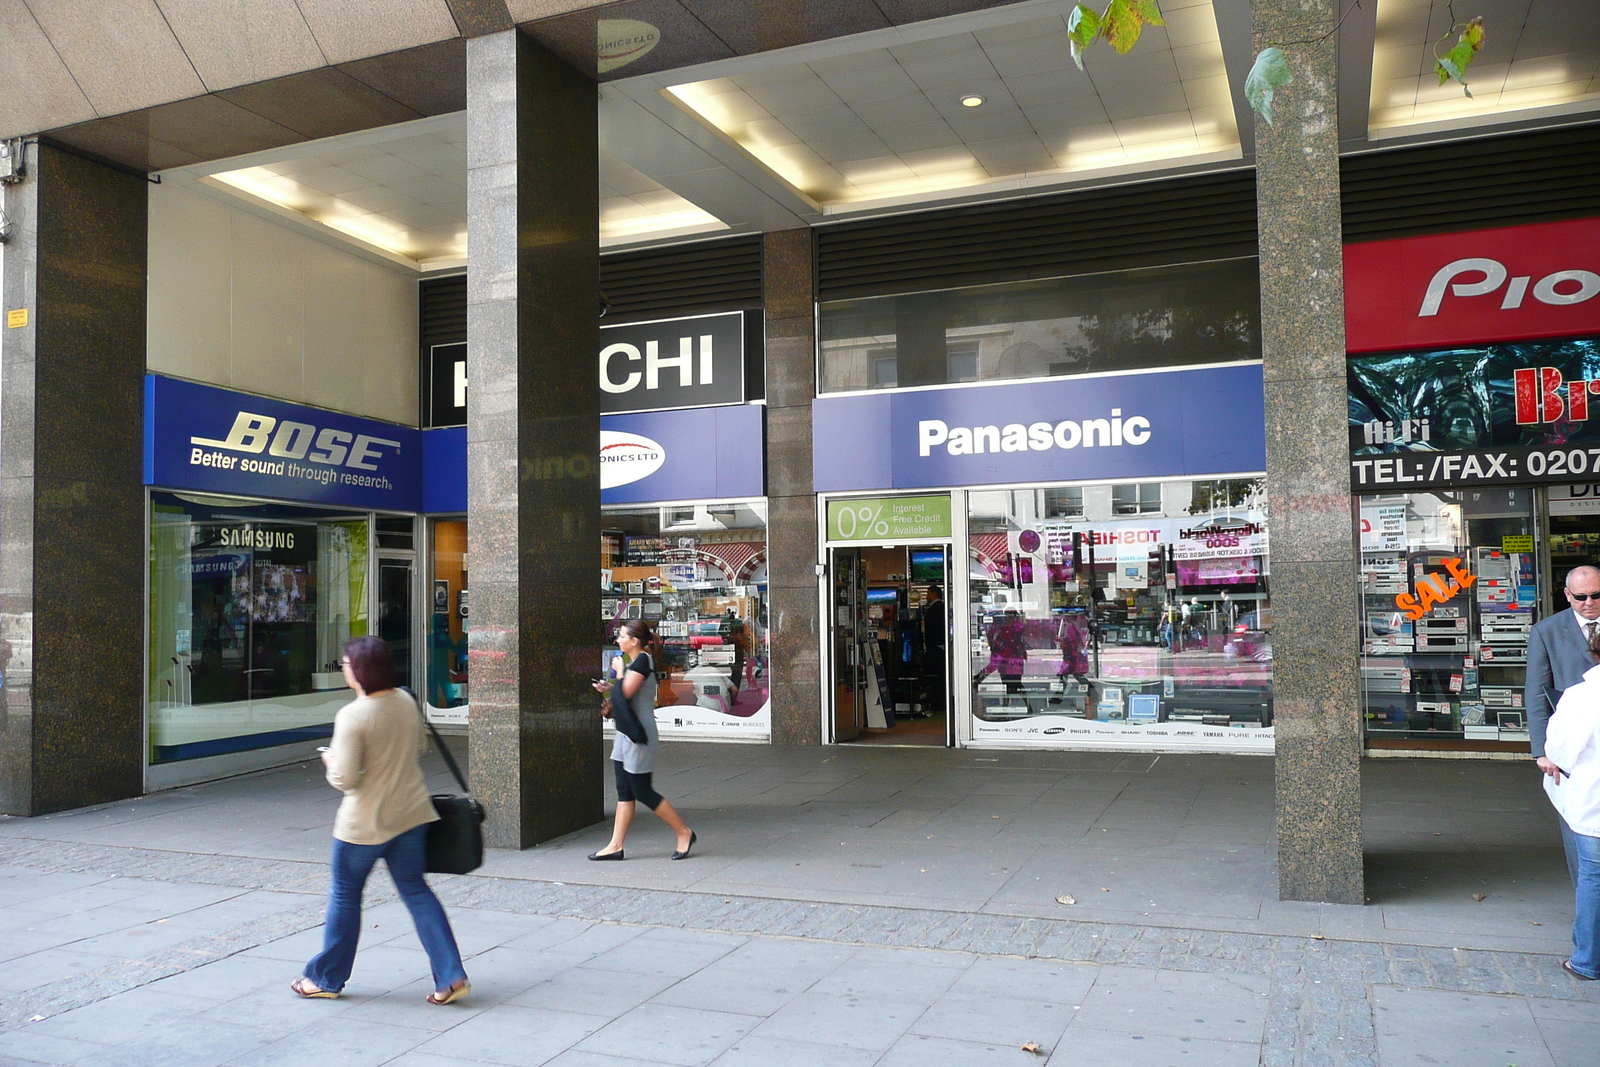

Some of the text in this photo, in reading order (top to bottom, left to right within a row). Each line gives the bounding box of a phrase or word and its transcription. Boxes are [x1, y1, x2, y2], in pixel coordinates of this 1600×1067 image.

[191, 411, 401, 471] BOSE
[918, 408, 1152, 457] Panasonic
[1363, 418, 1430, 445] Hi Fi
[190, 448, 388, 490] Better sound through research
[637, 453, 659, 461] LTD
[893, 504, 925, 513] Interest
[893, 513, 941, 524] Free Credit
[837, 505, 889, 538] 0%
[893, 526, 932, 535] Available
[220, 527, 295, 549] SAMSUNG
[182, 561, 237, 574] SAMSUNG
[1396, 557, 1477, 621] SALE
